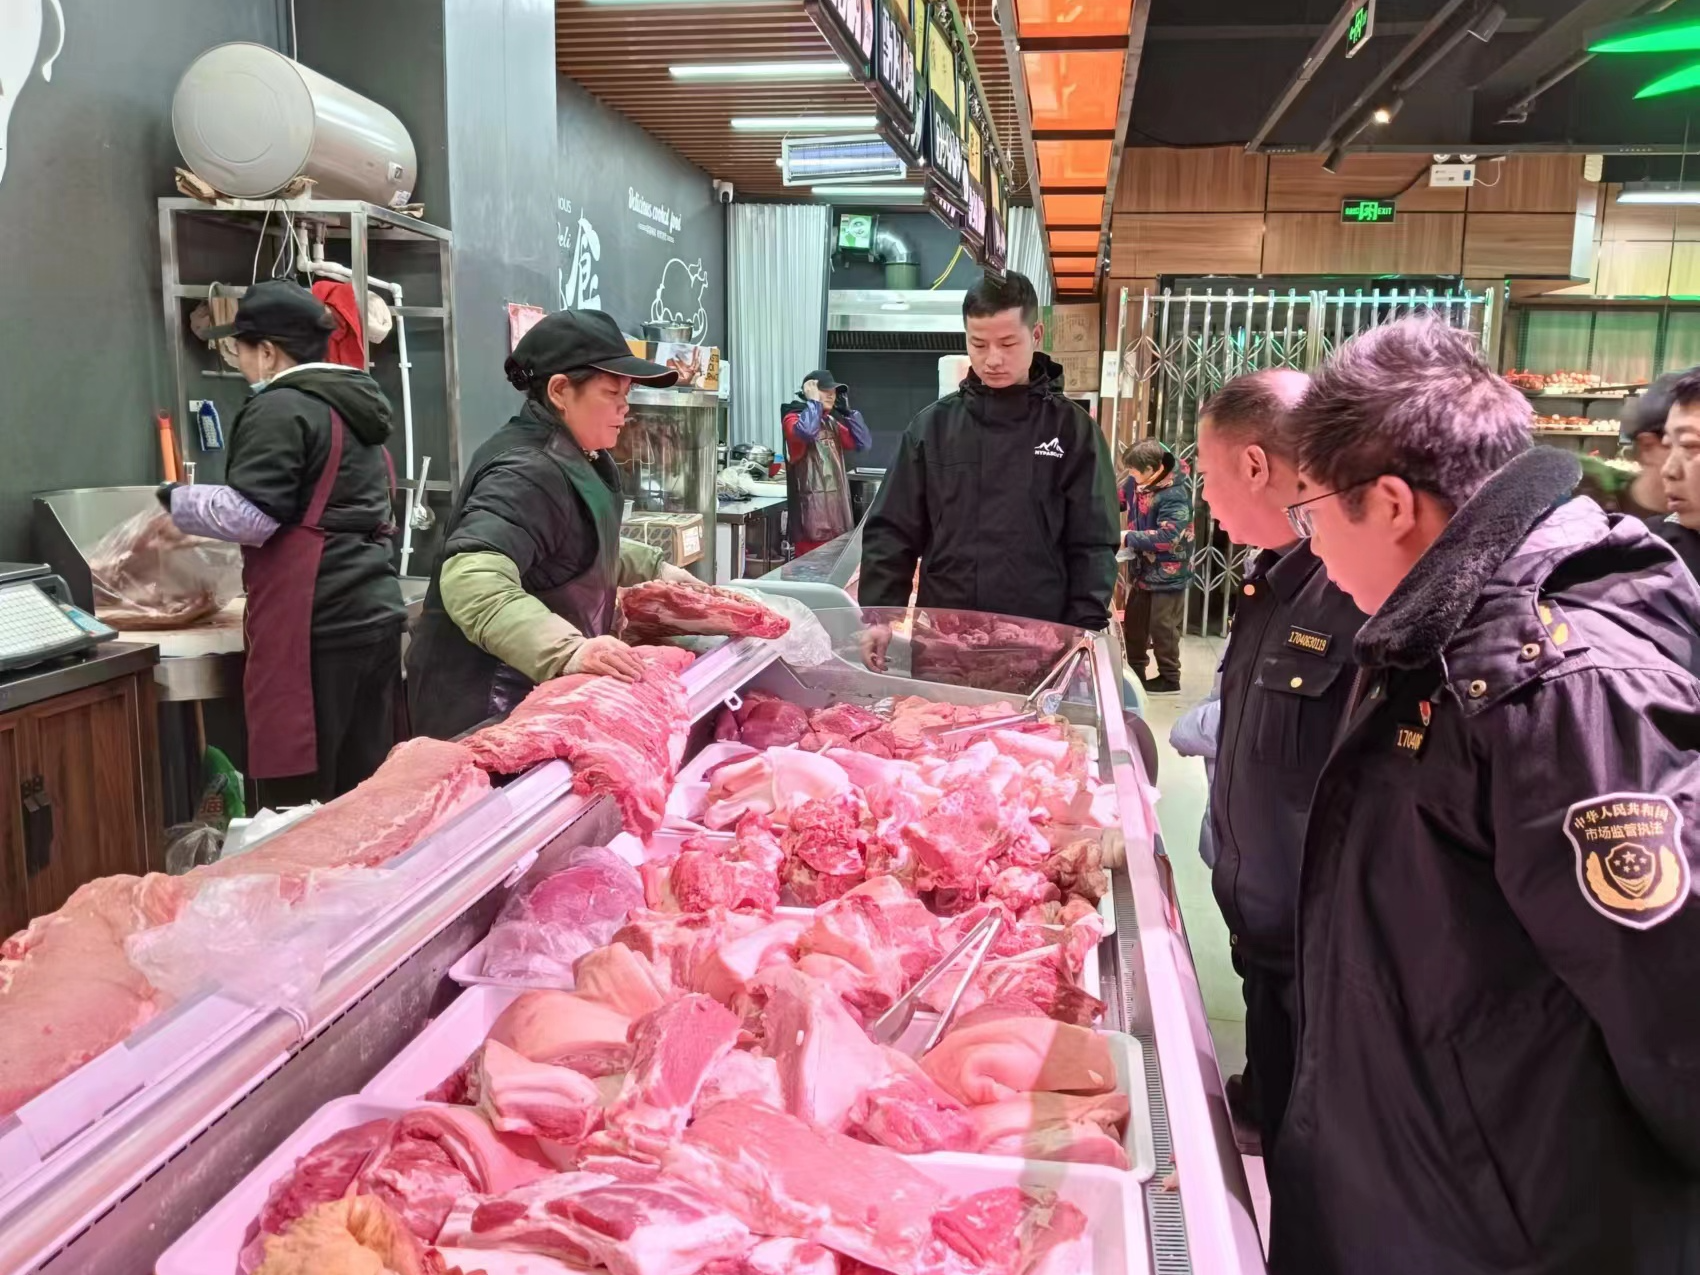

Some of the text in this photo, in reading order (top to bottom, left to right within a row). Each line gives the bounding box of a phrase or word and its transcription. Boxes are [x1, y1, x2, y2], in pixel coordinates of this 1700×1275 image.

[1378, 207, 1393, 215] EXIT
[558, 207, 601, 311] 食
[1574, 803, 1669, 829] 中华人民共和国
[1585, 822, 1664, 840] 市场监管执法
